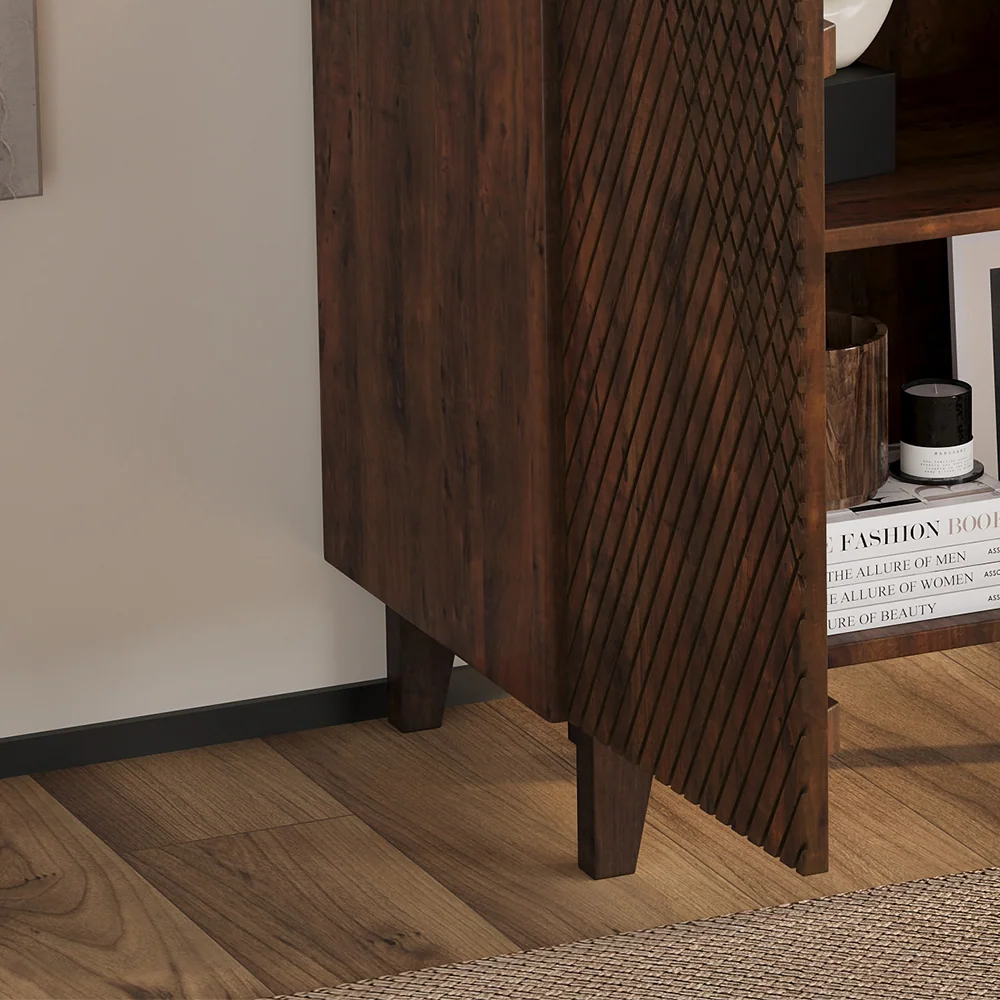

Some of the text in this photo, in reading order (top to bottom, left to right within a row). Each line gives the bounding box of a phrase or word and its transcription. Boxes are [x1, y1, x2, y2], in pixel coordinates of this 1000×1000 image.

[840, 520, 940, 552] FASHION
[827, 551, 966, 583] THE ALLURE OF MEN
[841, 584, 896, 603] ALLURE
[899, 581, 916, 593] OF
[920, 572, 974, 590] WOMEN
[859, 612, 877, 625] OF
[881, 603, 936, 621] BEAUTY
